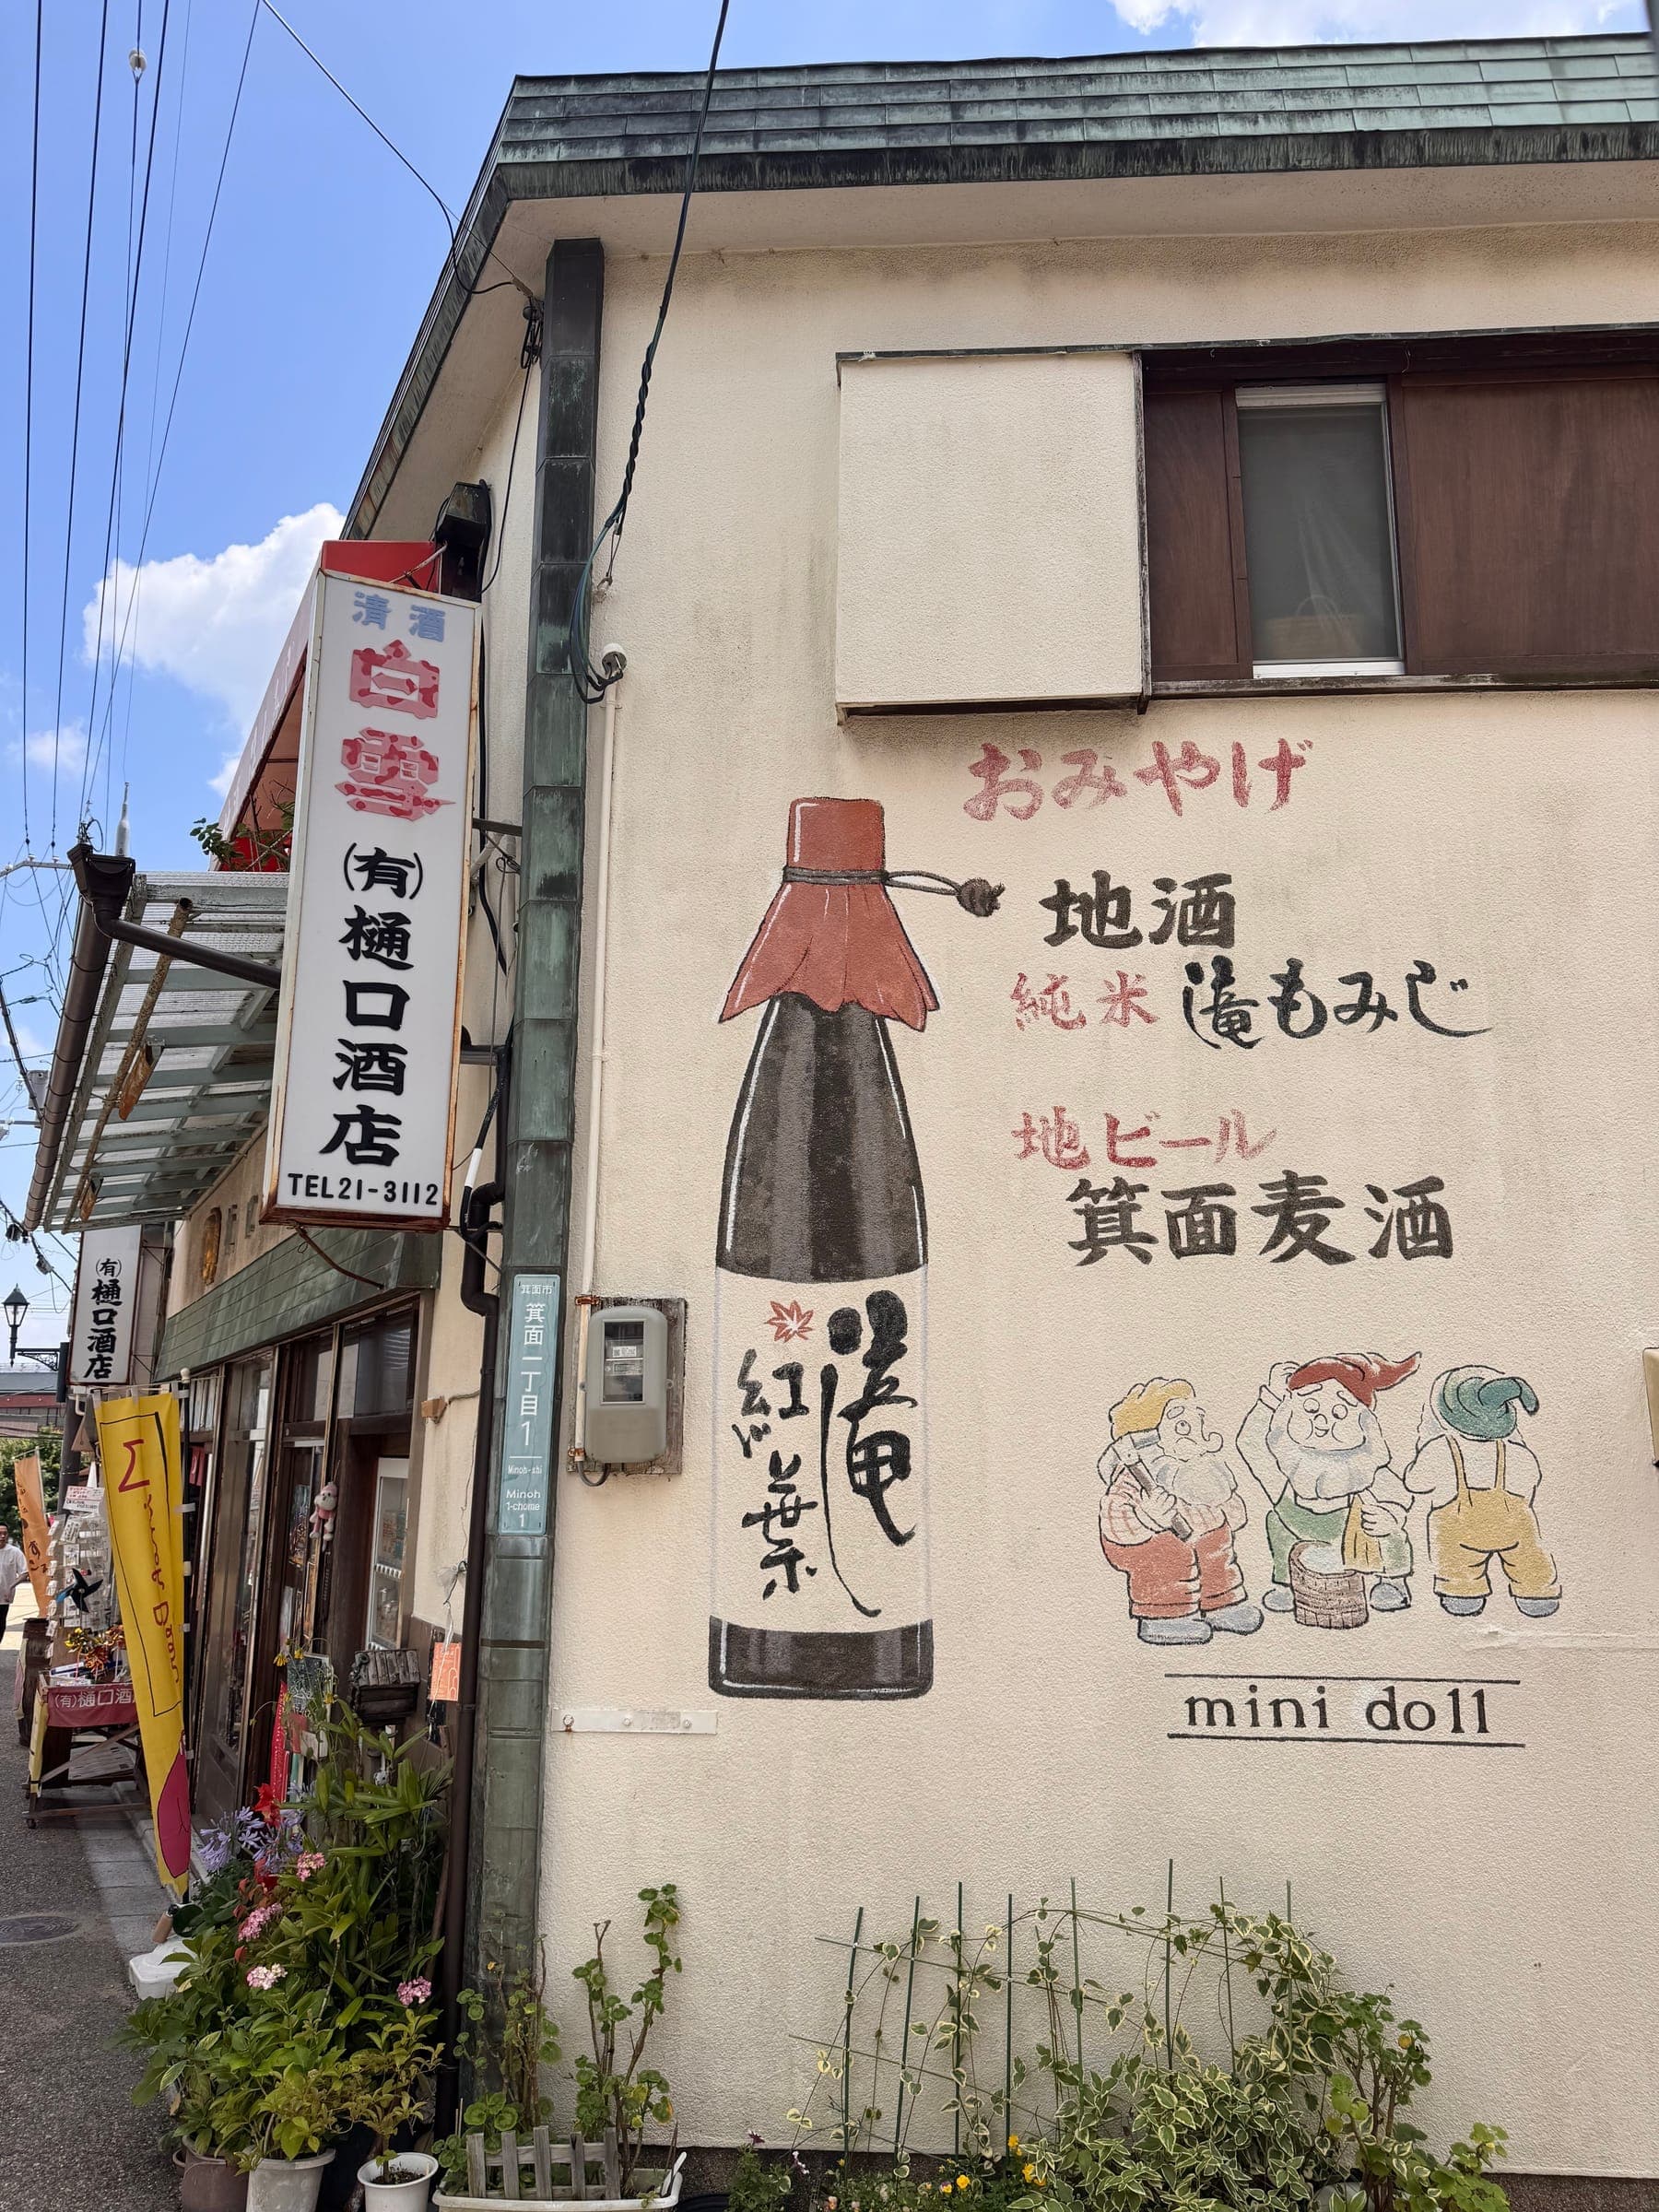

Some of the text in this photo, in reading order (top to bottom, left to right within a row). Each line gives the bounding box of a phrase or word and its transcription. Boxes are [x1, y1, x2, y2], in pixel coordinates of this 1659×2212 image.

[352, 591, 446, 642] 清酒
[335, 639, 456, 822] 白雪
[963, 738, 1313, 820] おみやげ
[1039, 870, 1235, 949] 地酒
[1010, 971, 1159, 1031] 純米
[1011, 1106, 1277, 1169] 地ビール
[1065, 1170, 1453, 1265] 箕面麦酒
[506, 1488, 541, 1499] Minoh
[508, 1464, 543, 1476] Minoh-shi
[506, 1501, 540, 1511] 1-chome
[519, 1513, 524, 1527] 1
[55, 1688, 135, 1709] (有)樋口酒
[1185, 1686, 1489, 1734] mini doll
